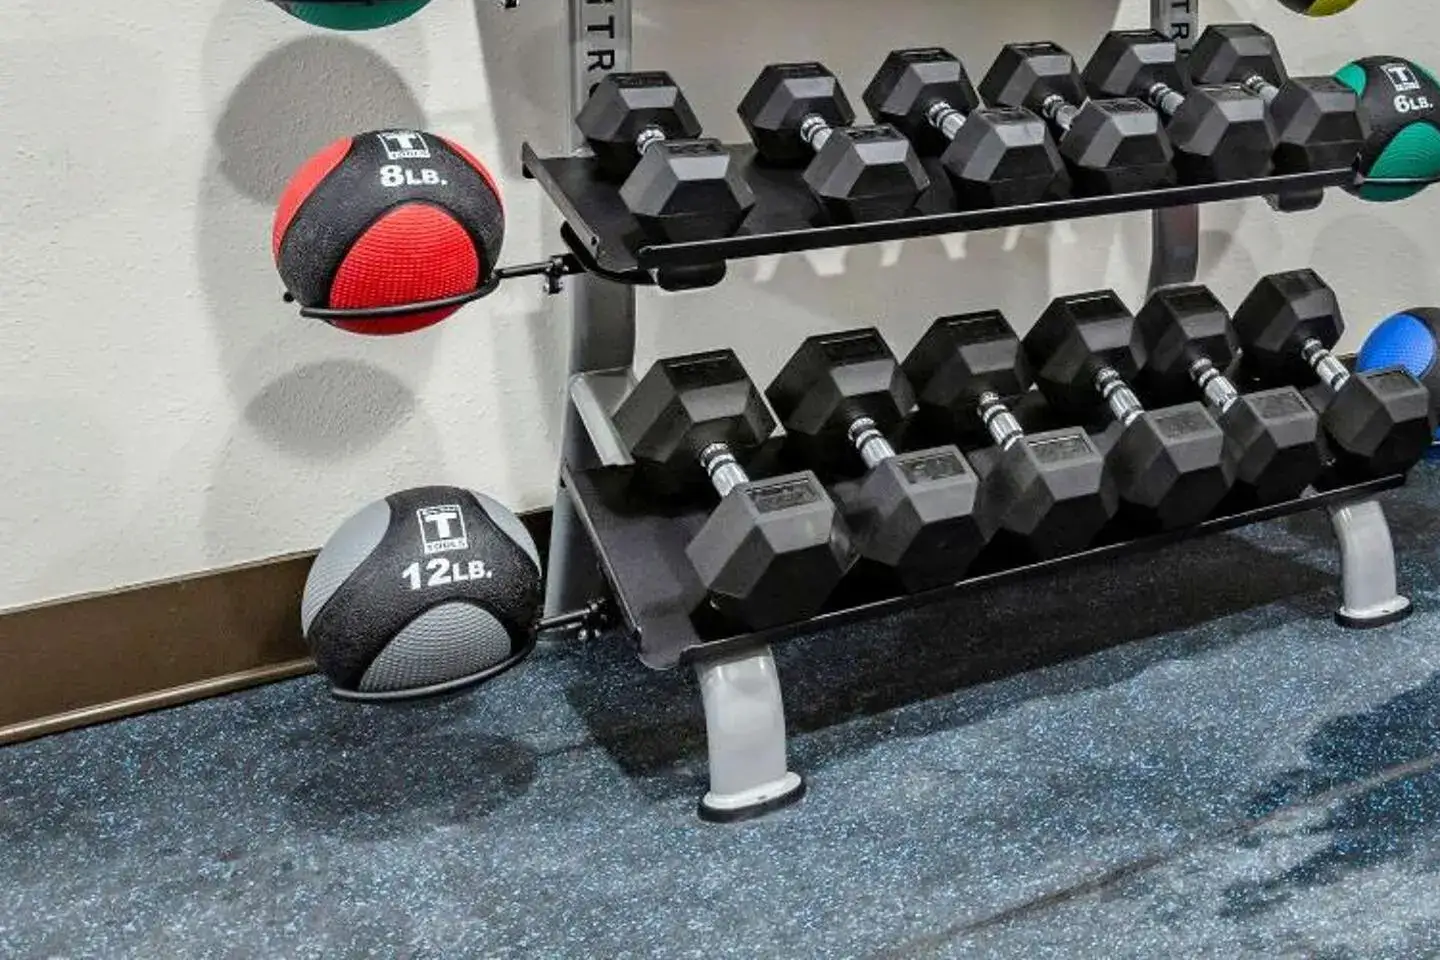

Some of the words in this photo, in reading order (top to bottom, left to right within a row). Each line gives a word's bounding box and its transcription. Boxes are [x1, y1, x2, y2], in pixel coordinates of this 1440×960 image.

[586, 14, 615, 98] TR
[1393, 94, 1434, 113] 6LB.
[379, 164, 448, 187] 8LB.
[423, 511, 458, 539] T
[401, 557, 493, 590] 12LB.
